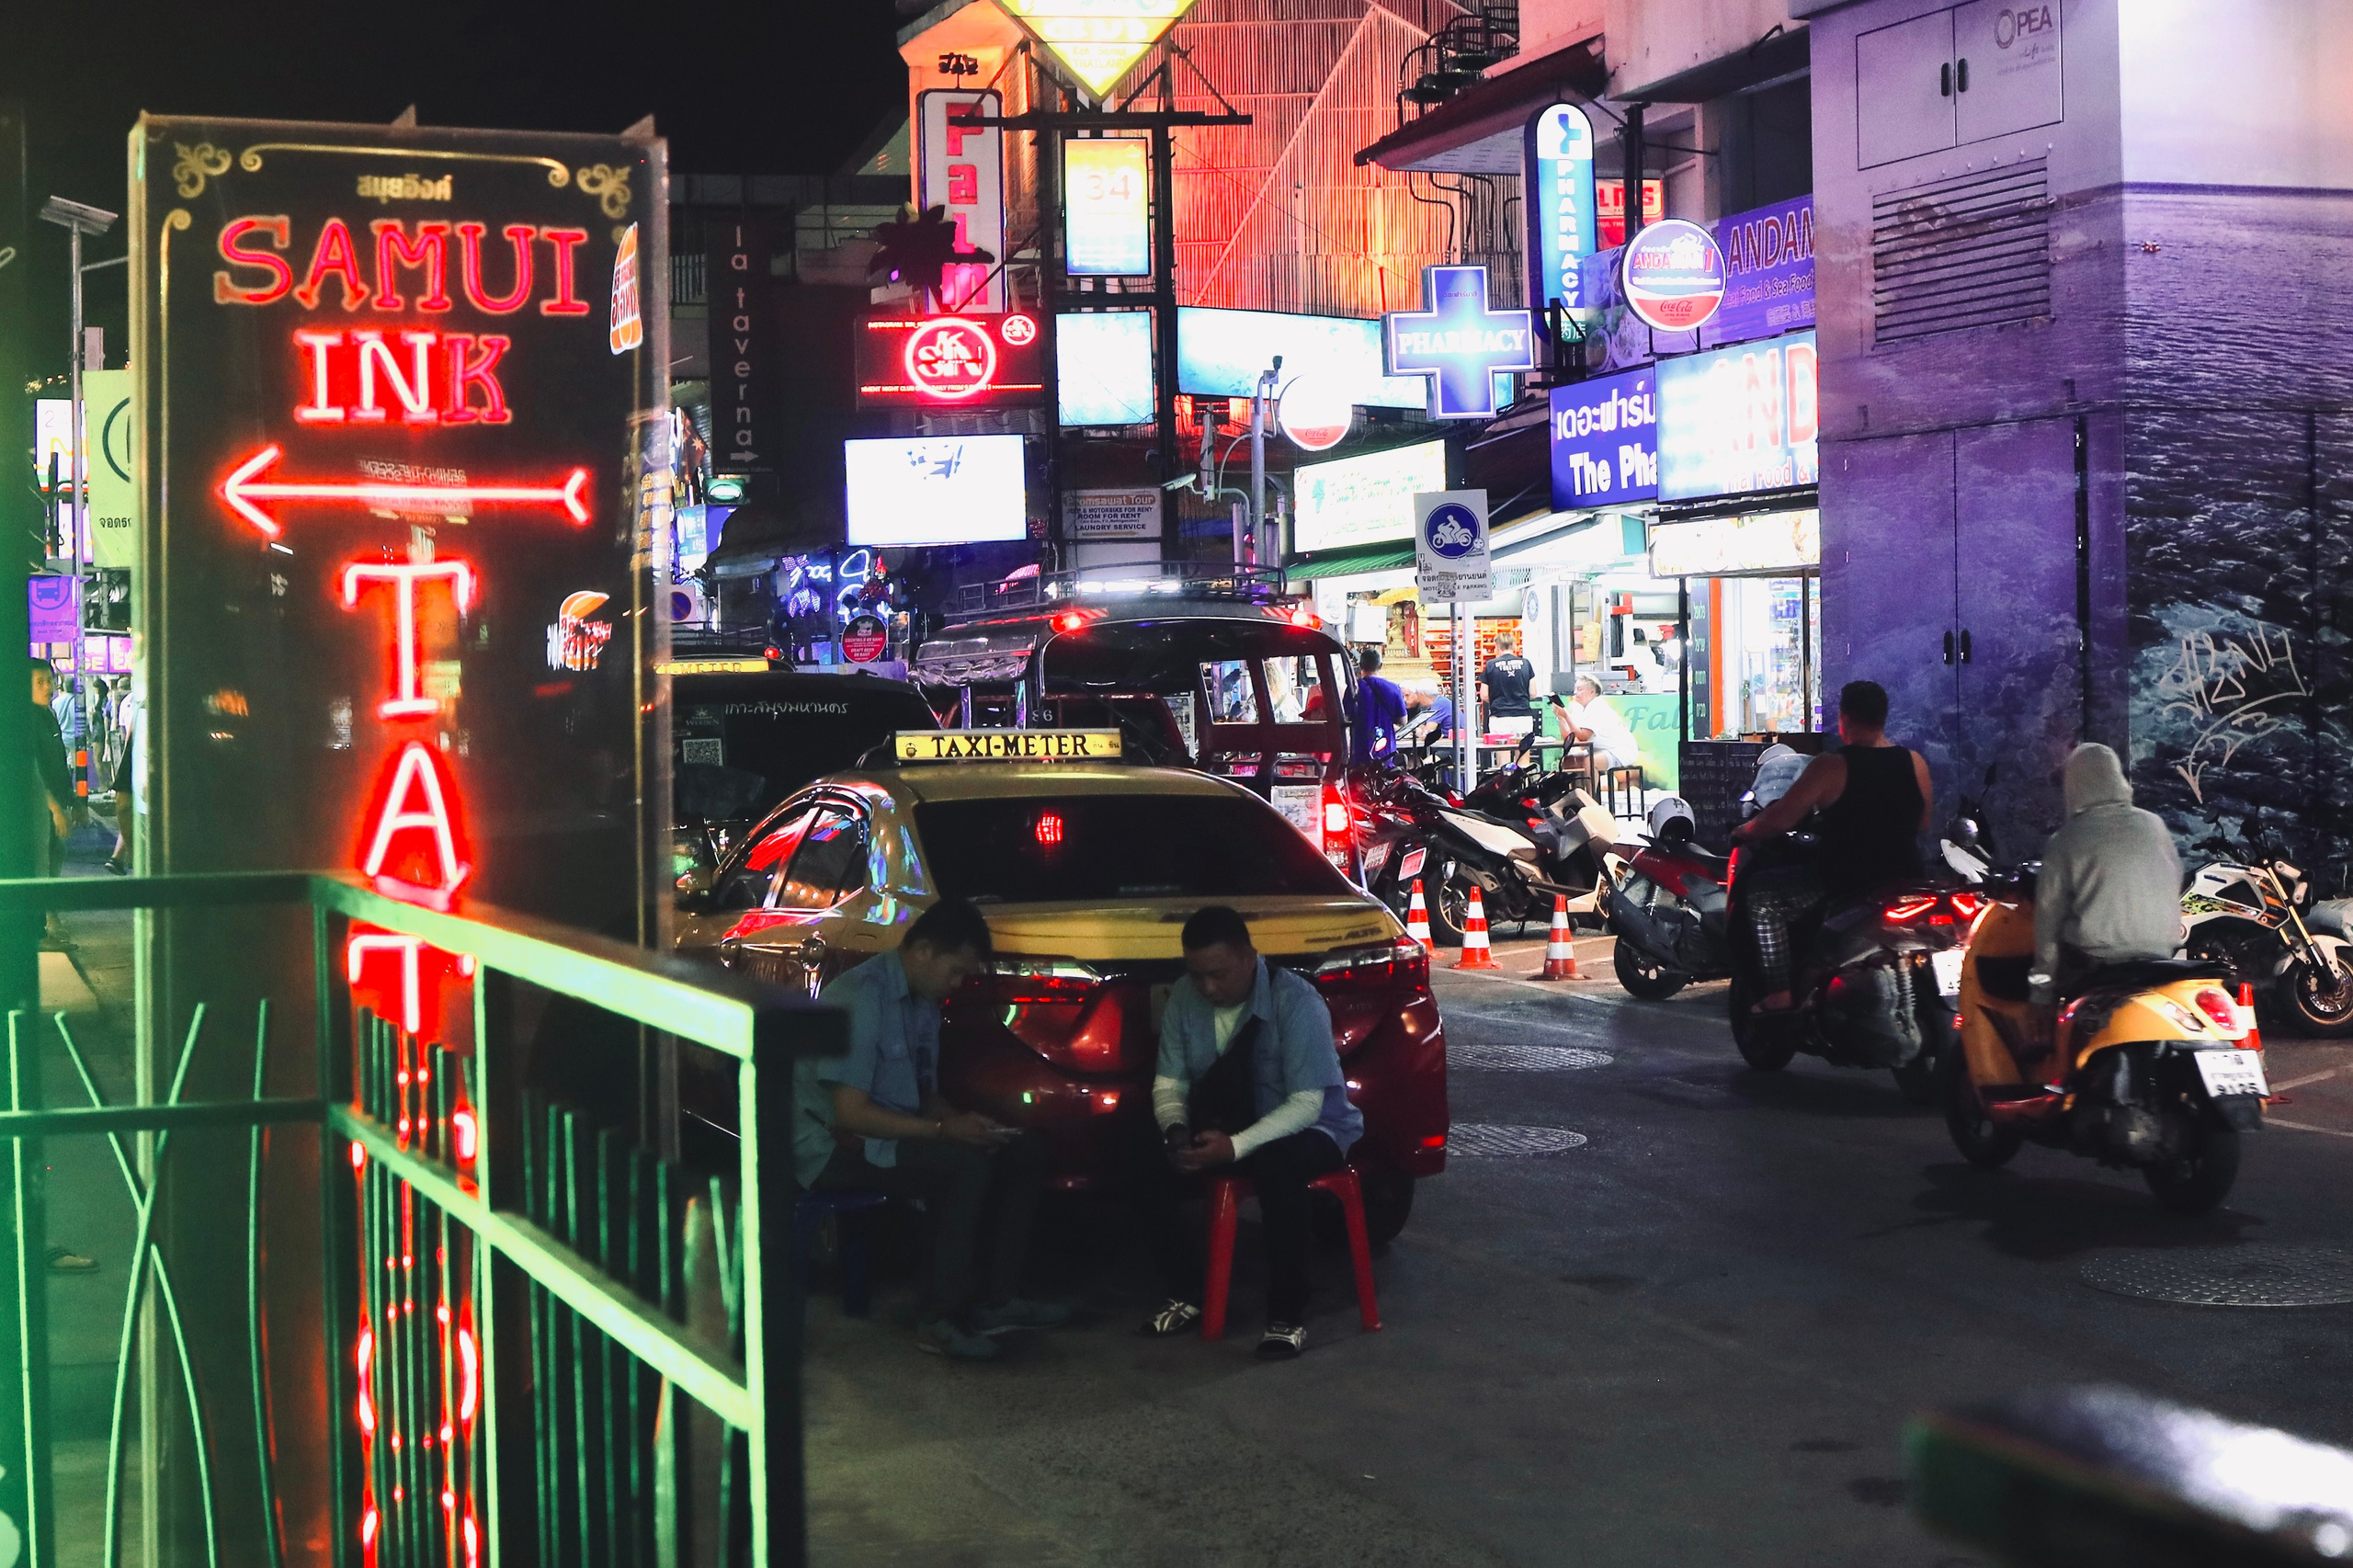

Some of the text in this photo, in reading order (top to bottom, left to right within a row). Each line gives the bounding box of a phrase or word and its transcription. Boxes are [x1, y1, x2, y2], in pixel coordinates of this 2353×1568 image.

[2017, 5, 2052, 37] PEA
[1073, 58, 1126, 69] THAILAND
[1086, 174, 1131, 201] 34
[1557, 159, 1579, 307] PHARMACY
[213, 214, 590, 315] SAMUI
[1632, 252, 1704, 269] ANDA
[1772, 277, 1789, 297] Sea
[1789, 268, 1814, 293] Food
[1397, 328, 1527, 355] PHARMACY
[293, 328, 513, 426] INK
[733, 287, 752, 448] taverna
[1569, 452, 1611, 496] The
[1131, 494, 1154, 505] Tour
[931, 734, 1091, 758] TAXI-METER
